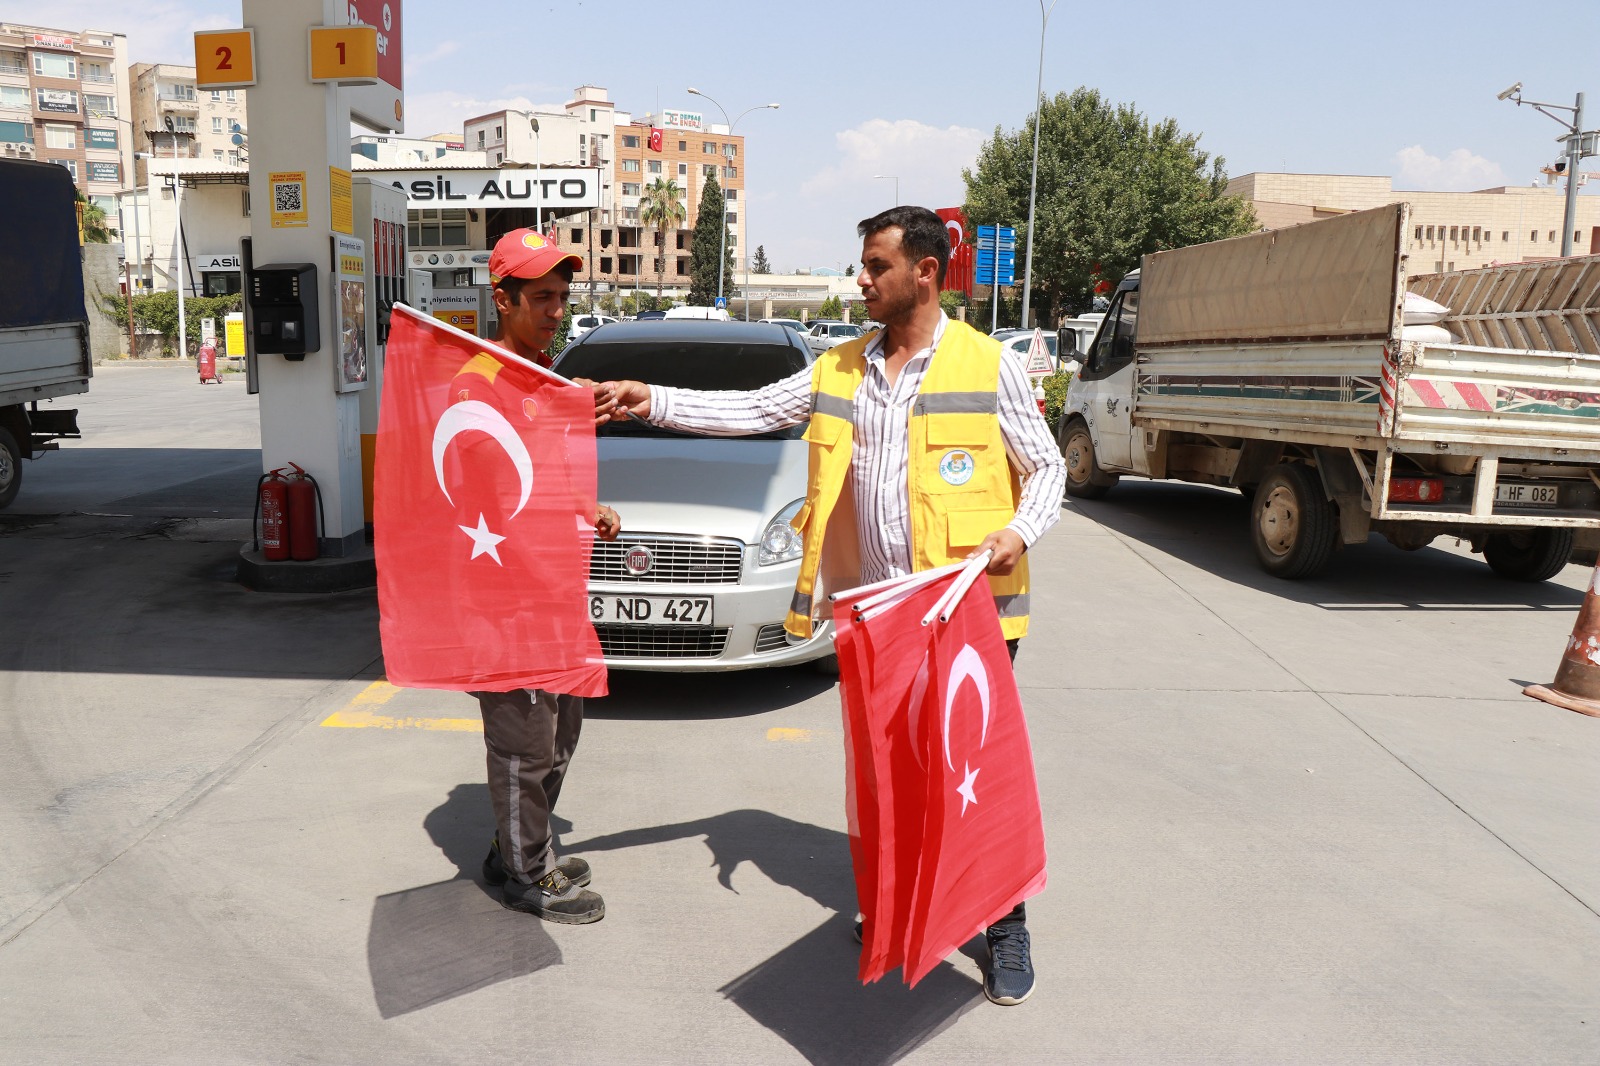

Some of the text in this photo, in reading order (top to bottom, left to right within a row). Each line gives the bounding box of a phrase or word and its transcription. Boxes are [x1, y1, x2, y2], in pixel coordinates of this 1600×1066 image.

[215, 46, 232, 70] 2
[335, 42, 346, 65] 1
[392, 175, 587, 200] SİL AUTO
[432, 296, 462, 304] niyetiniz
[1495, 486, 1556, 502] 1 HF 082
[631, 555, 647, 568] FIAT
[590, 597, 709, 622] 6 ND 427
